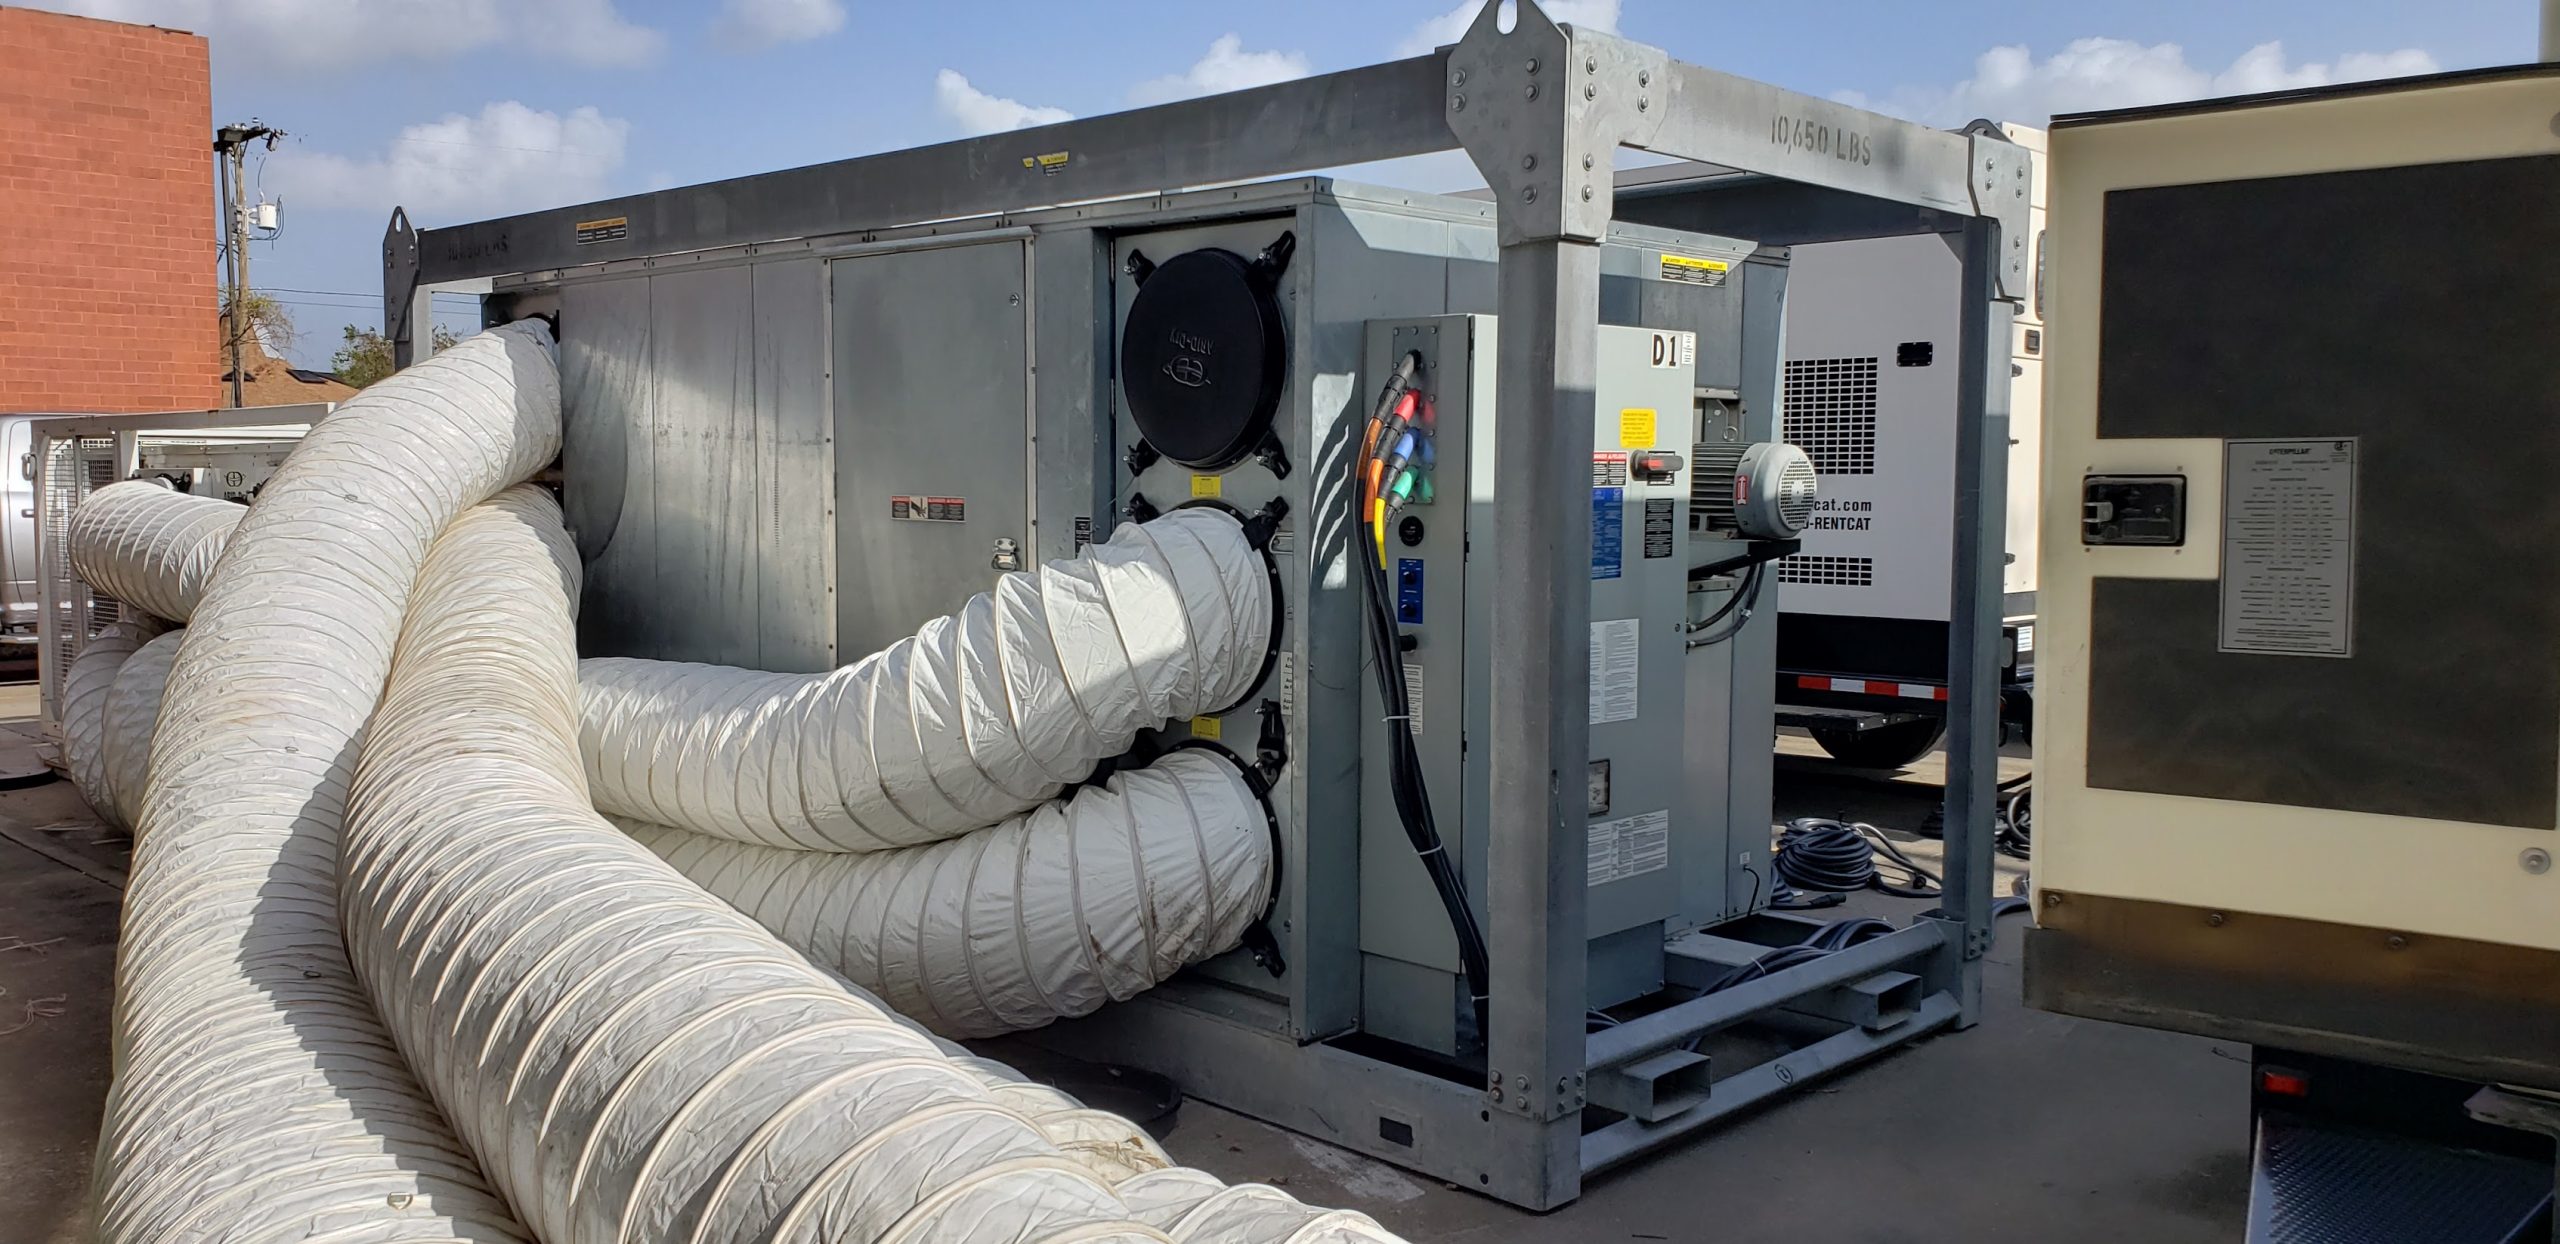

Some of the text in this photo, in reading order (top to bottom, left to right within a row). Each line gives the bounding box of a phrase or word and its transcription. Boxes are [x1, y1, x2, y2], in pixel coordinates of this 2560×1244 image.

[1771, 115, 1872, 167] 10,650 LBS
[1653, 334, 1677, 366] D1
[1814, 498, 1872, 512] cat.com
